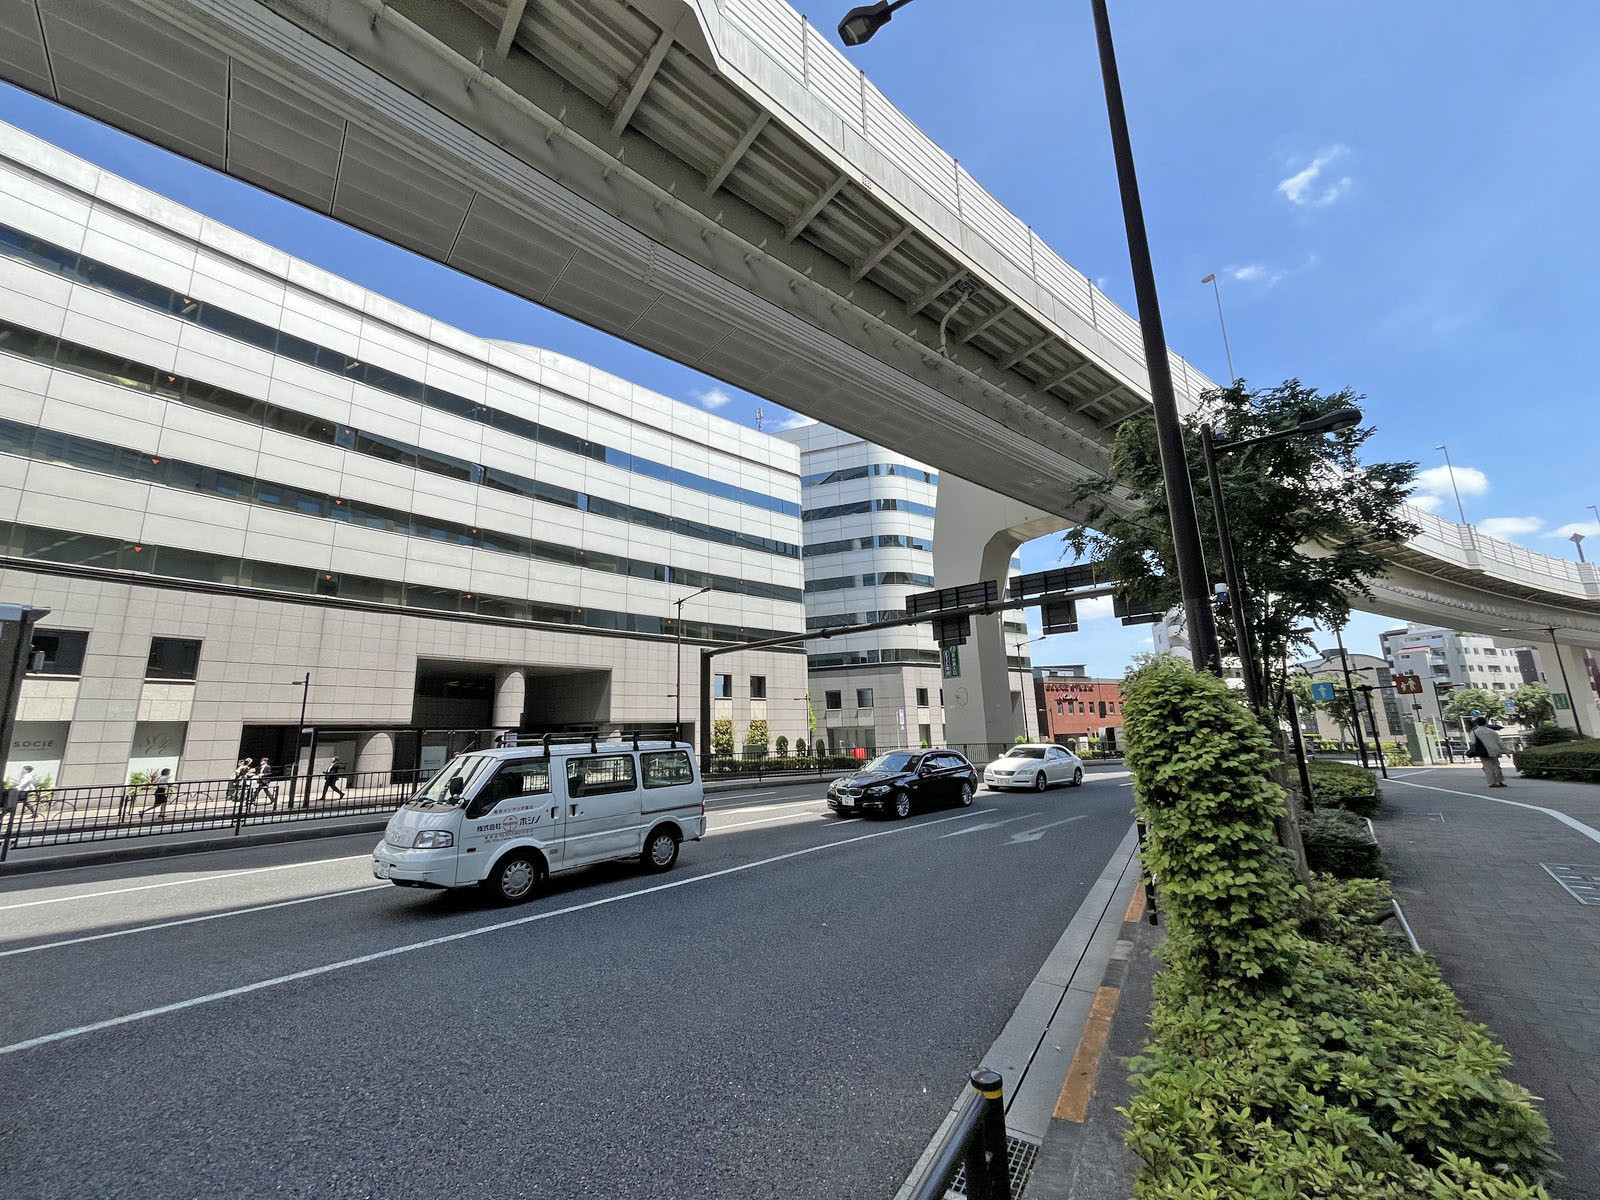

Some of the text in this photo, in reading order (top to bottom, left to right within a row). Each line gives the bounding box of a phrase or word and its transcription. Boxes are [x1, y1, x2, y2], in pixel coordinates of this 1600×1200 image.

[476, 823, 501, 832] 株式会社
[519, 815, 541, 826] ホシノ
